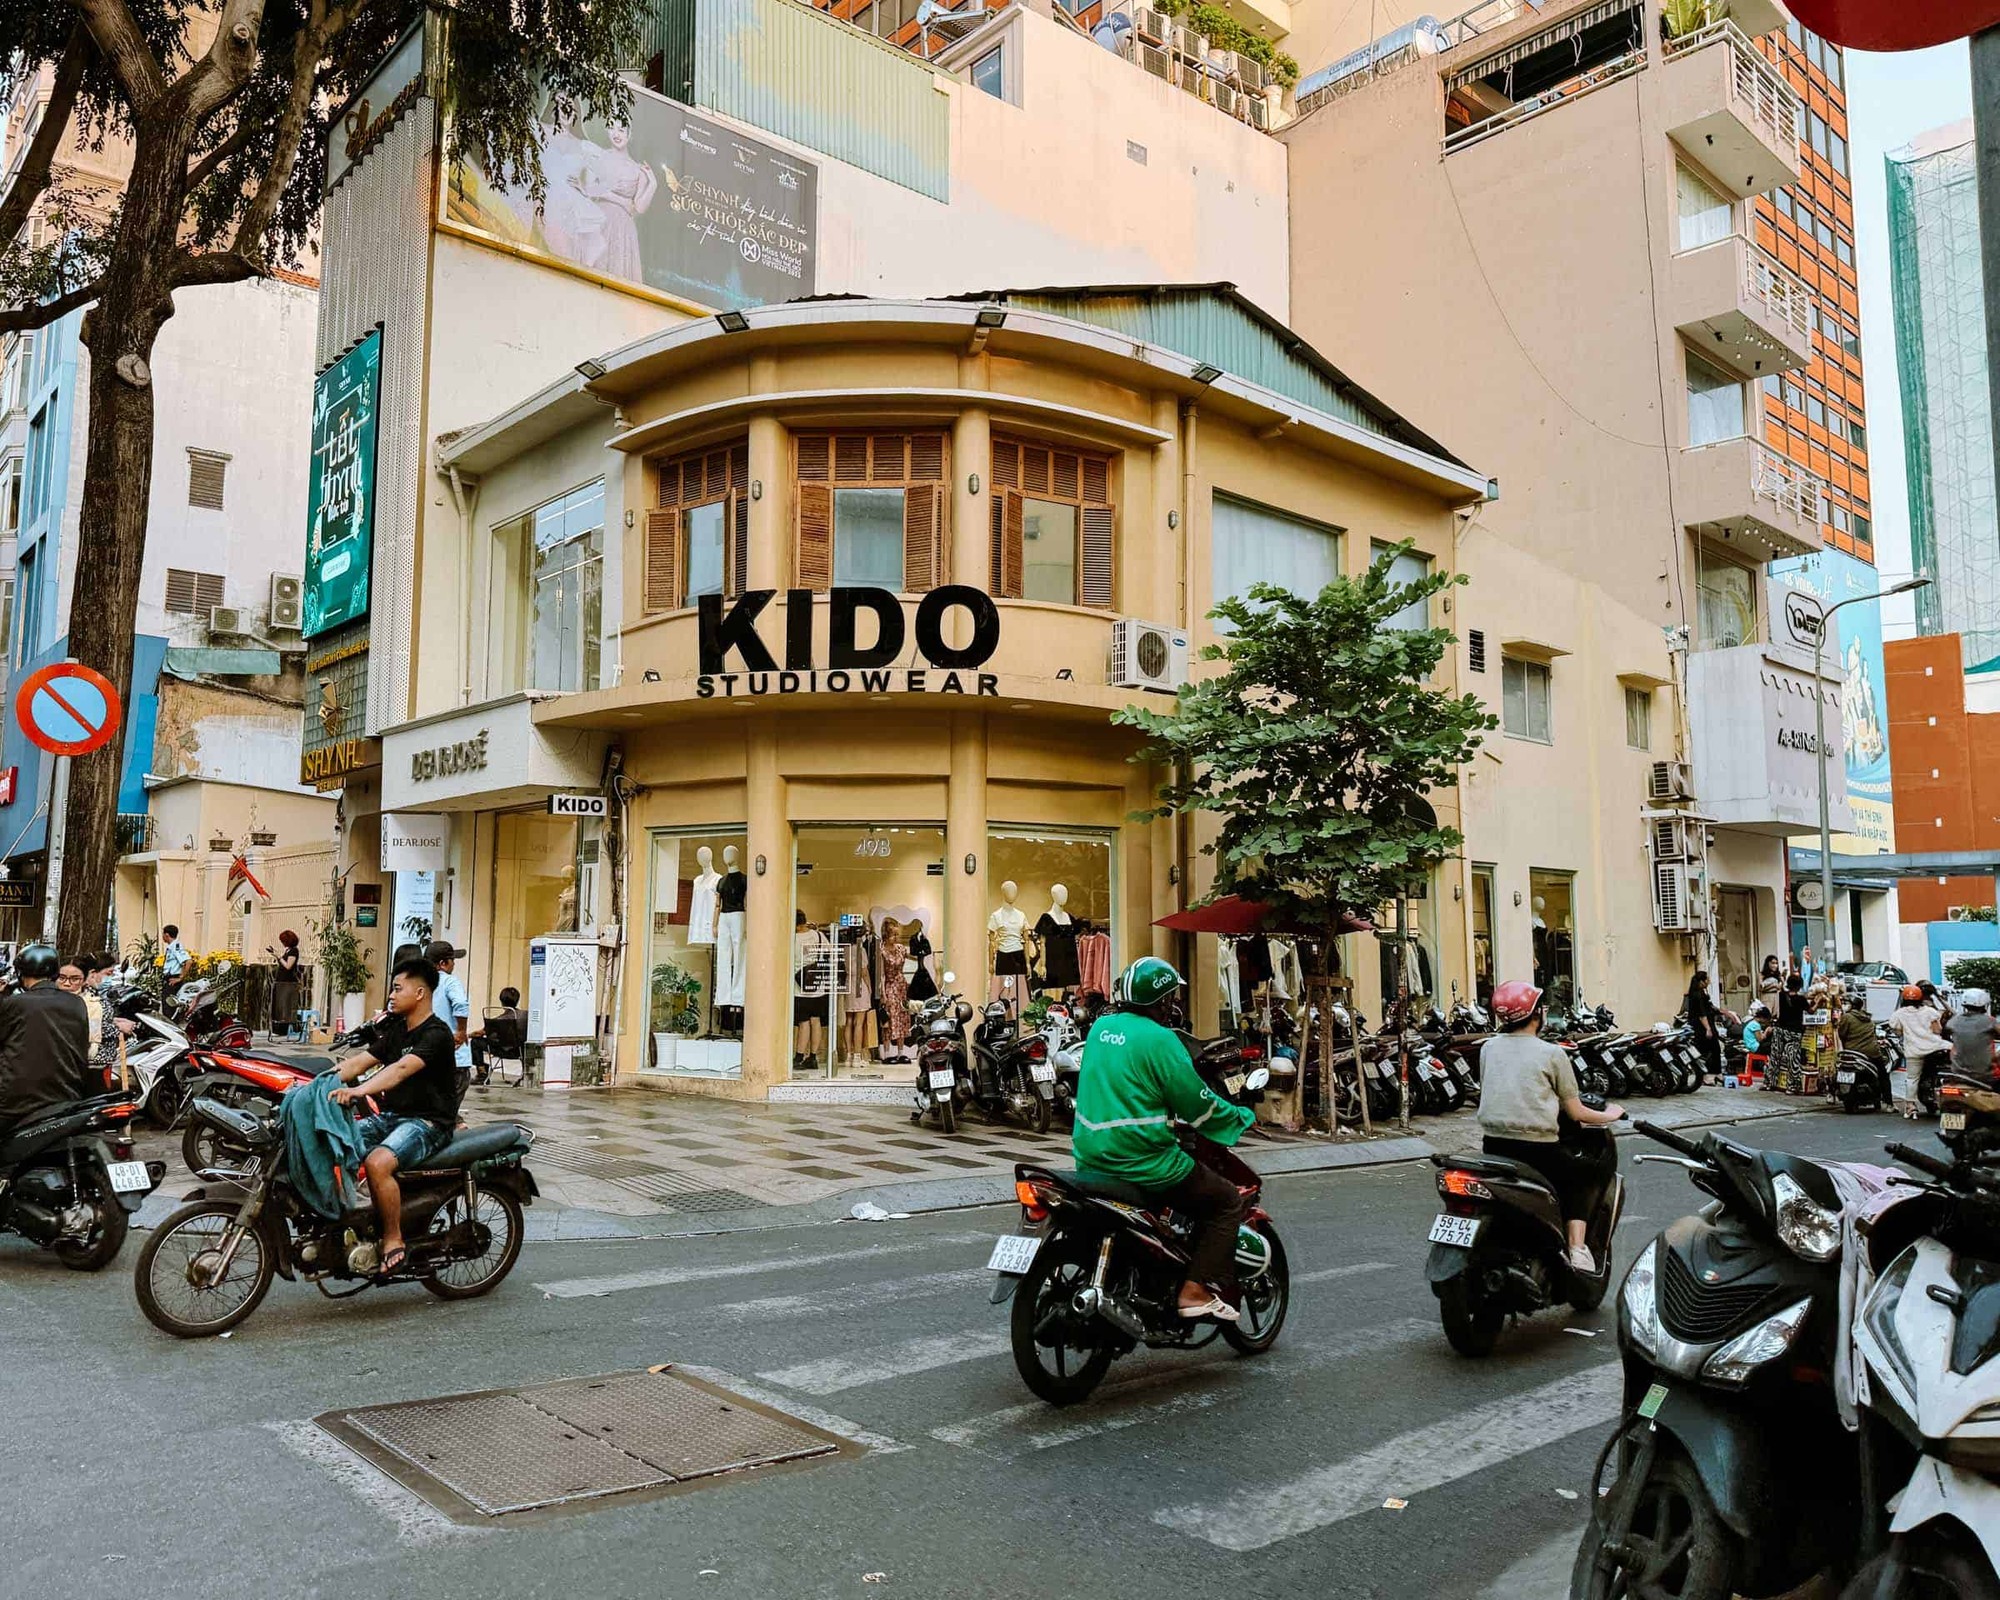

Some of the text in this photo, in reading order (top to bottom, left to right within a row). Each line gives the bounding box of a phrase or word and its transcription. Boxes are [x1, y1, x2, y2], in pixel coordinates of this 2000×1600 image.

[694, 181, 740, 208] SHYNH
[761, 244, 802, 266] Miss World
[698, 585, 1000, 675] KIDO
[696, 670, 999, 698] STUDIOWEAR
[558, 798, 603, 813] KIDO
[392, 836, 442, 848] DEARJOSÉ
[1152, 972, 1172, 989] Grab
[1099, 1029, 1126, 1046] Grab
